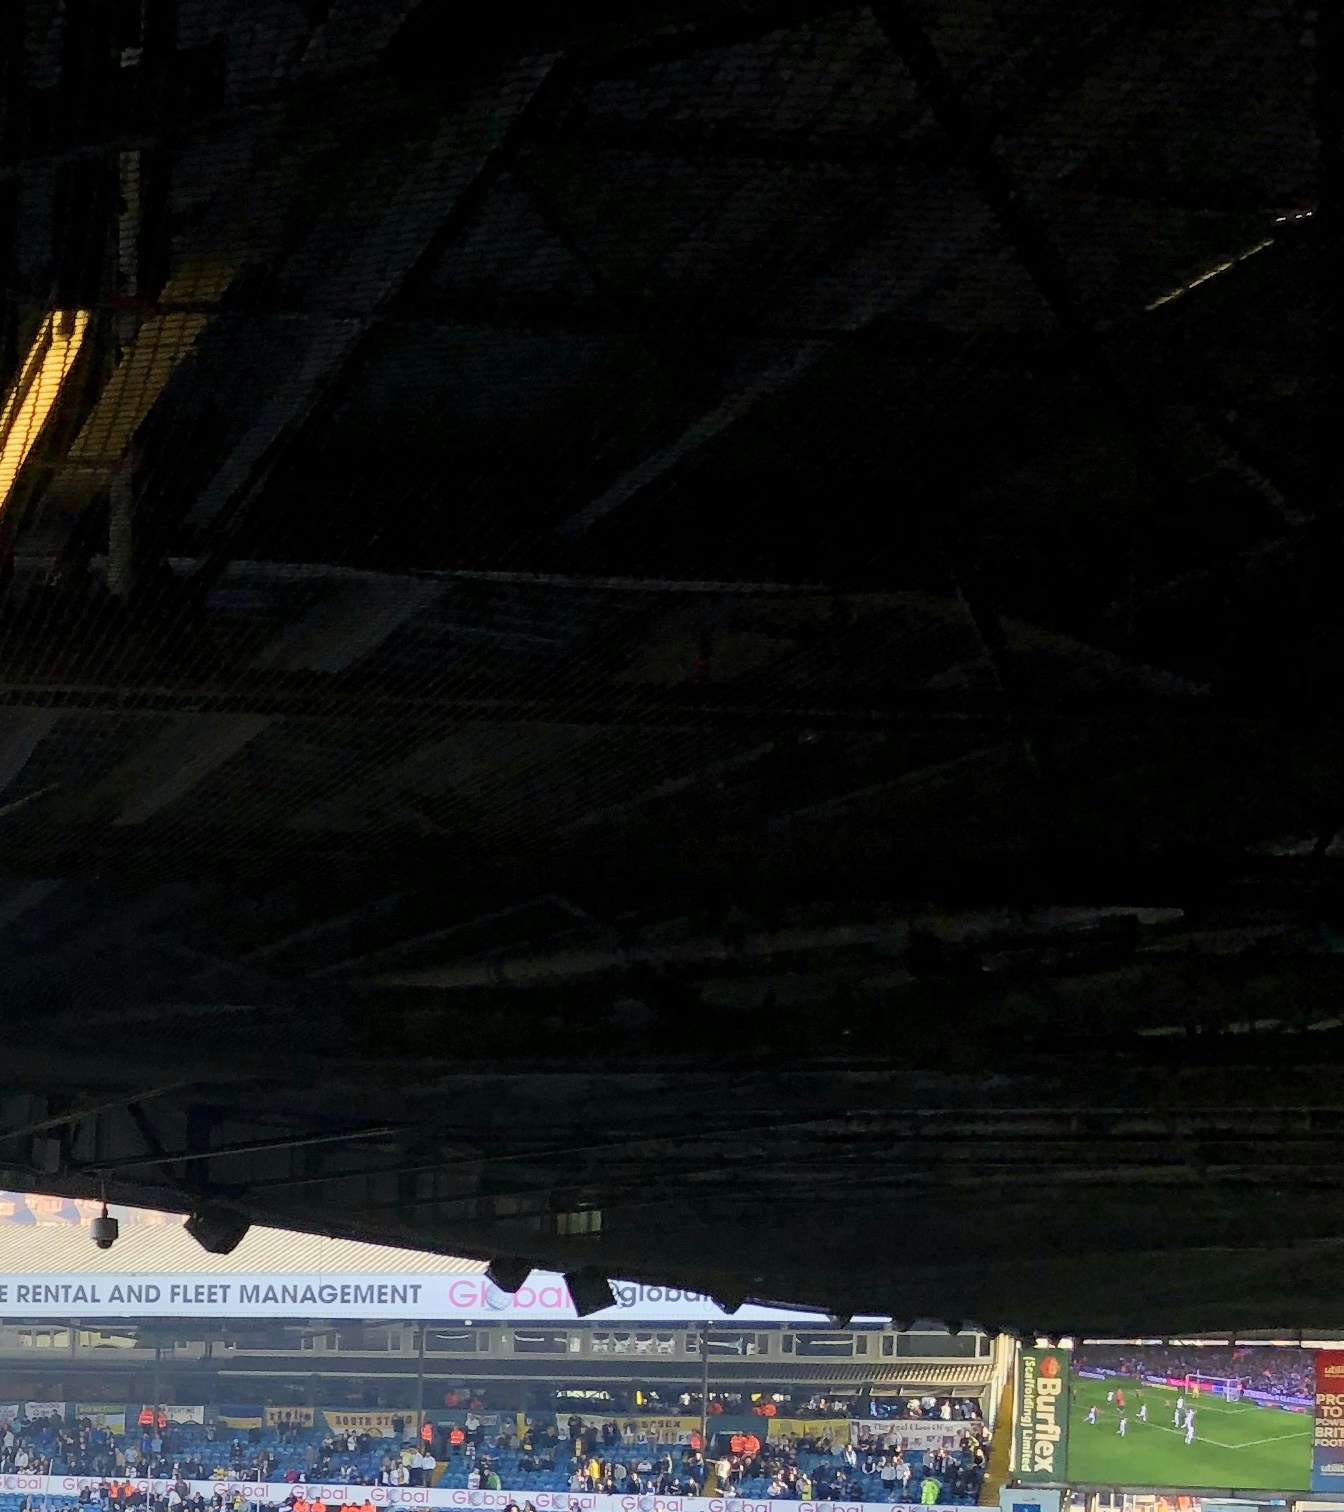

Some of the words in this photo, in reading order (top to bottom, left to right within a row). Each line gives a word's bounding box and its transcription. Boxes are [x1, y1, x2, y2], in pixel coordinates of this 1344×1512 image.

[16, 1284, 100, 1304] RENTAL
[108, 1284, 161, 1304] AND
[170, 1284, 231, 1304] FLEET
[240, 1284, 422, 1305] MANAGEMENT
[335, 1415, 371, 1426] SOUTH
[1322, 1406, 1342, 1417] TO
[1034, 1378, 1062, 1473] Burflex
[1021, 1430, 1033, 1472] Limited
